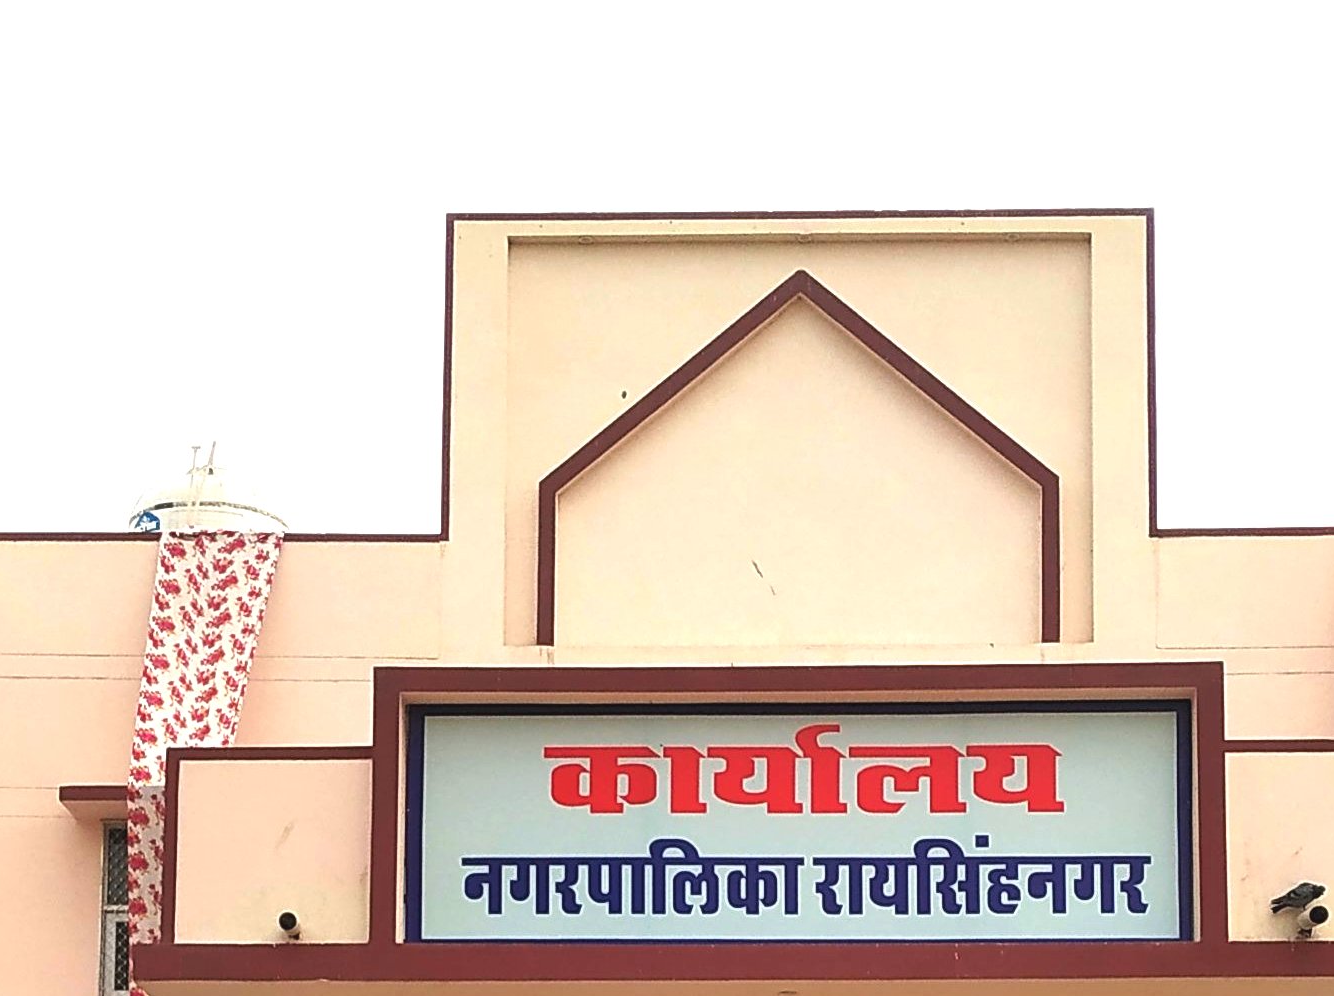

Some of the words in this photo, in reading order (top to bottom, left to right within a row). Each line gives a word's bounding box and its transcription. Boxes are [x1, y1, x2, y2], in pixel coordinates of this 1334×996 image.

[543, 724, 1065, 814] कार्यालय
[462, 837, 803, 917] नगरपालिका
[813, 834, 1152, 916] रायसिंहनगर
